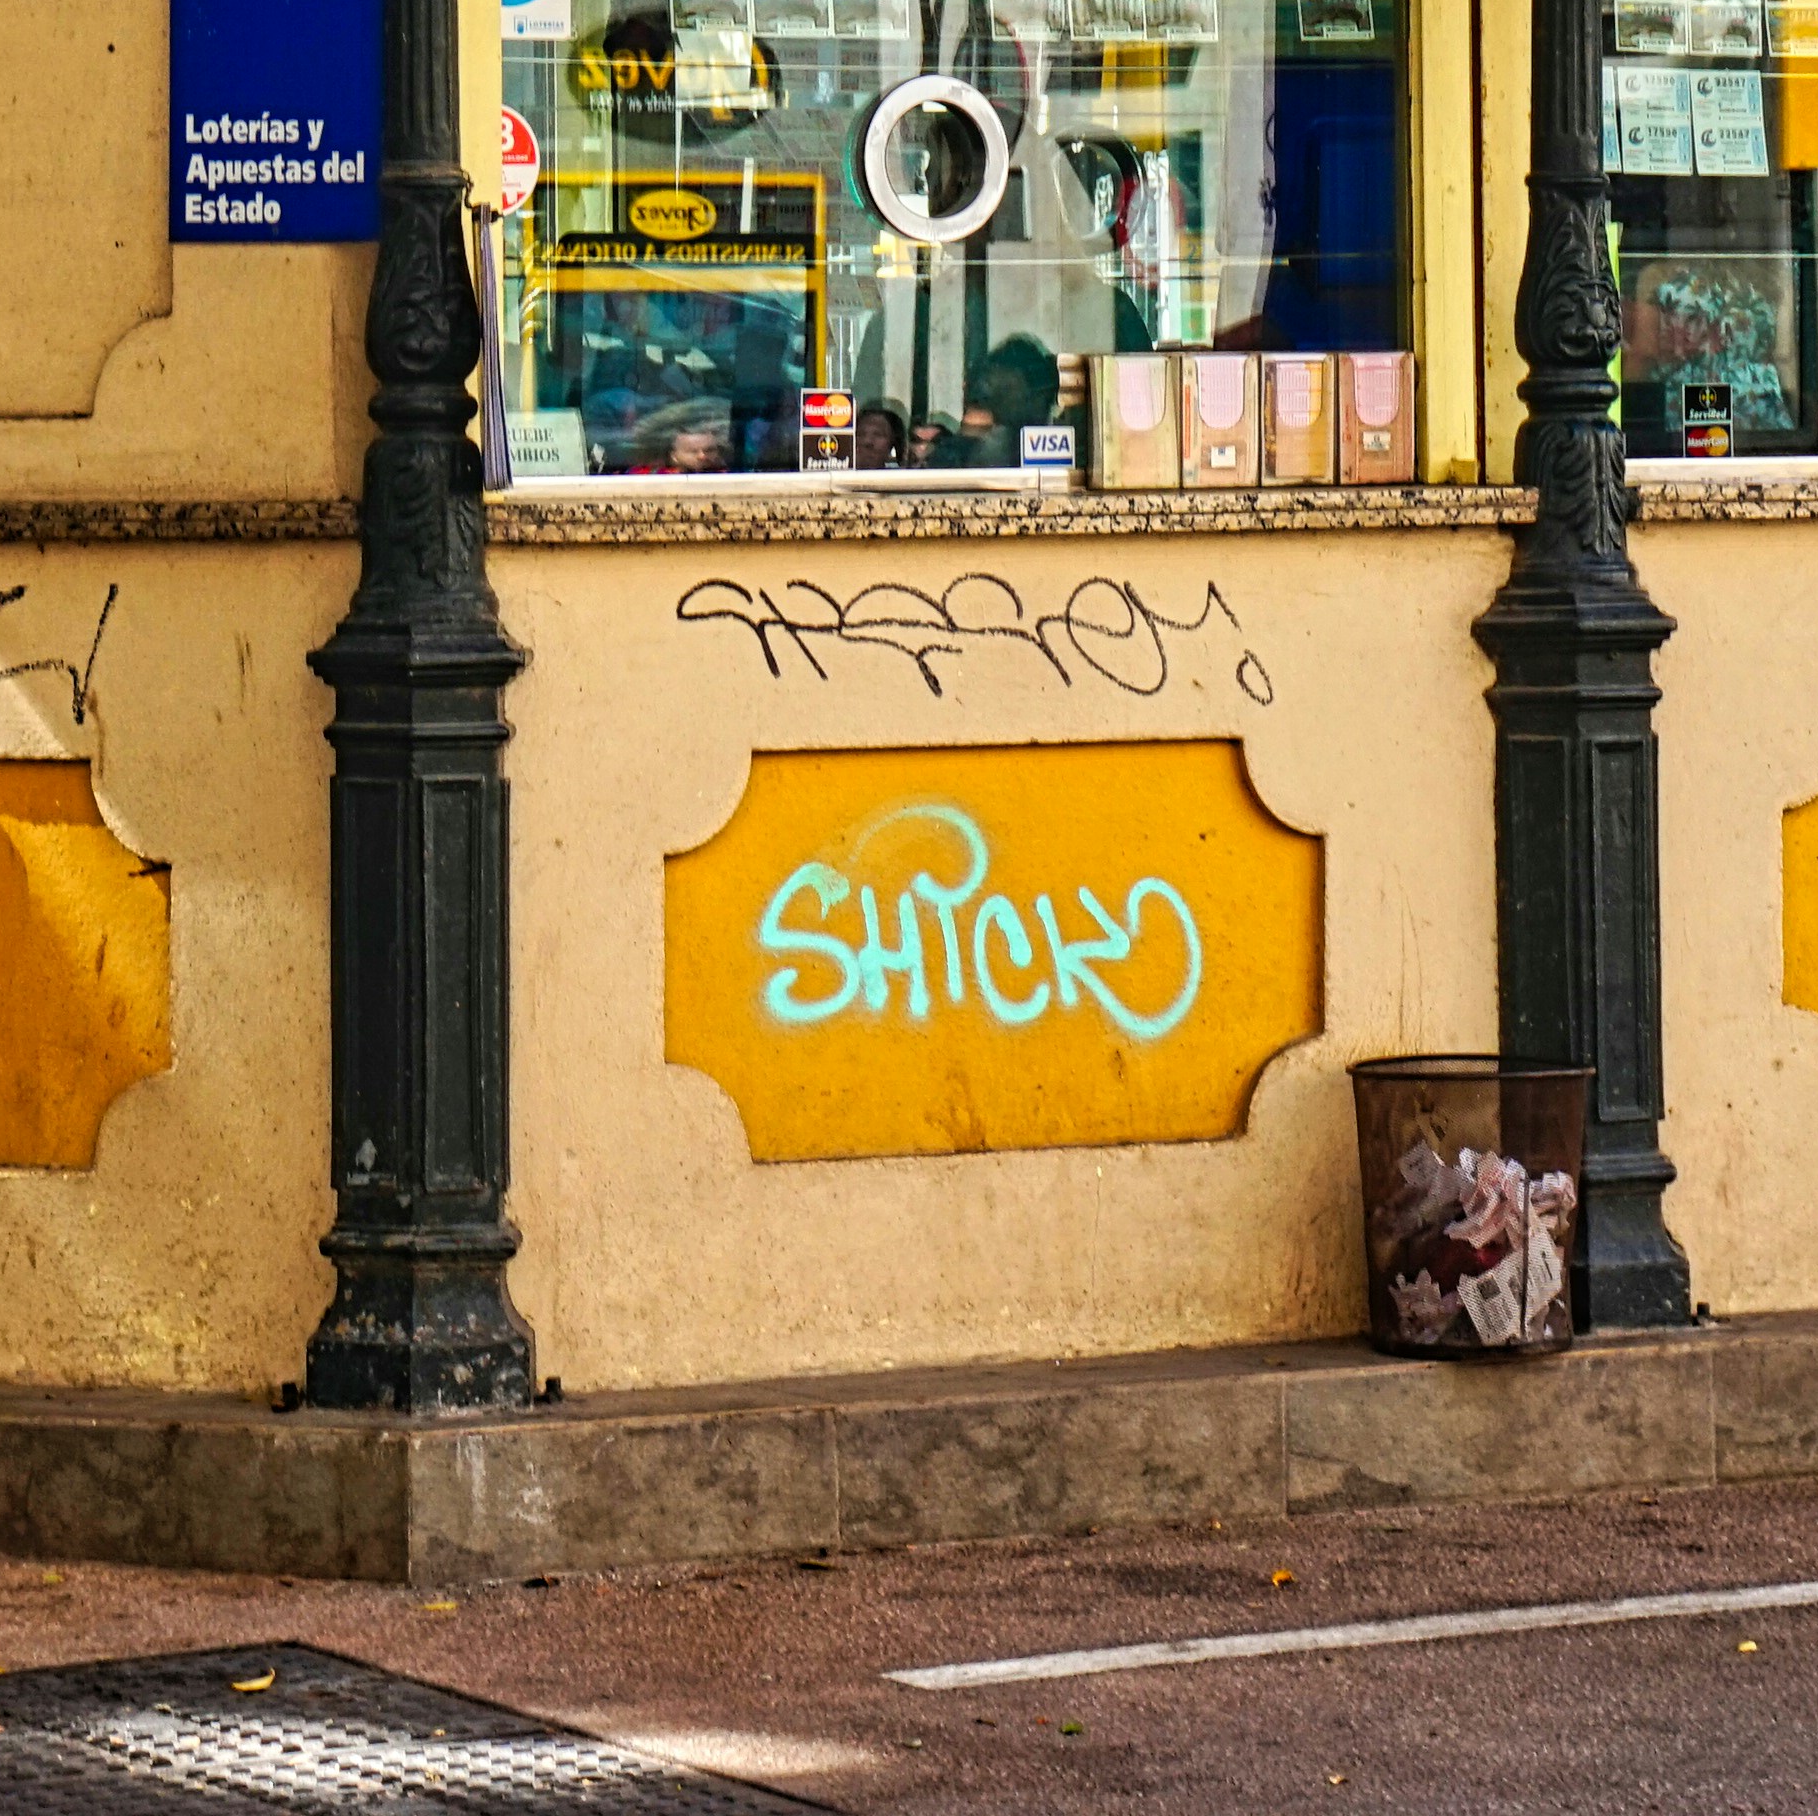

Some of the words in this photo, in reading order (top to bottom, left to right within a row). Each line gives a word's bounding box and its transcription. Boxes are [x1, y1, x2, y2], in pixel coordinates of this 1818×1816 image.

[184, 109, 301, 146] Loterías
[308, 119, 324, 151] y
[185, 154, 317, 190] Apuestas
[321, 150, 365, 184] del
[184, 191, 282, 226] Estado
[1028, 435, 1071, 453] VISA
